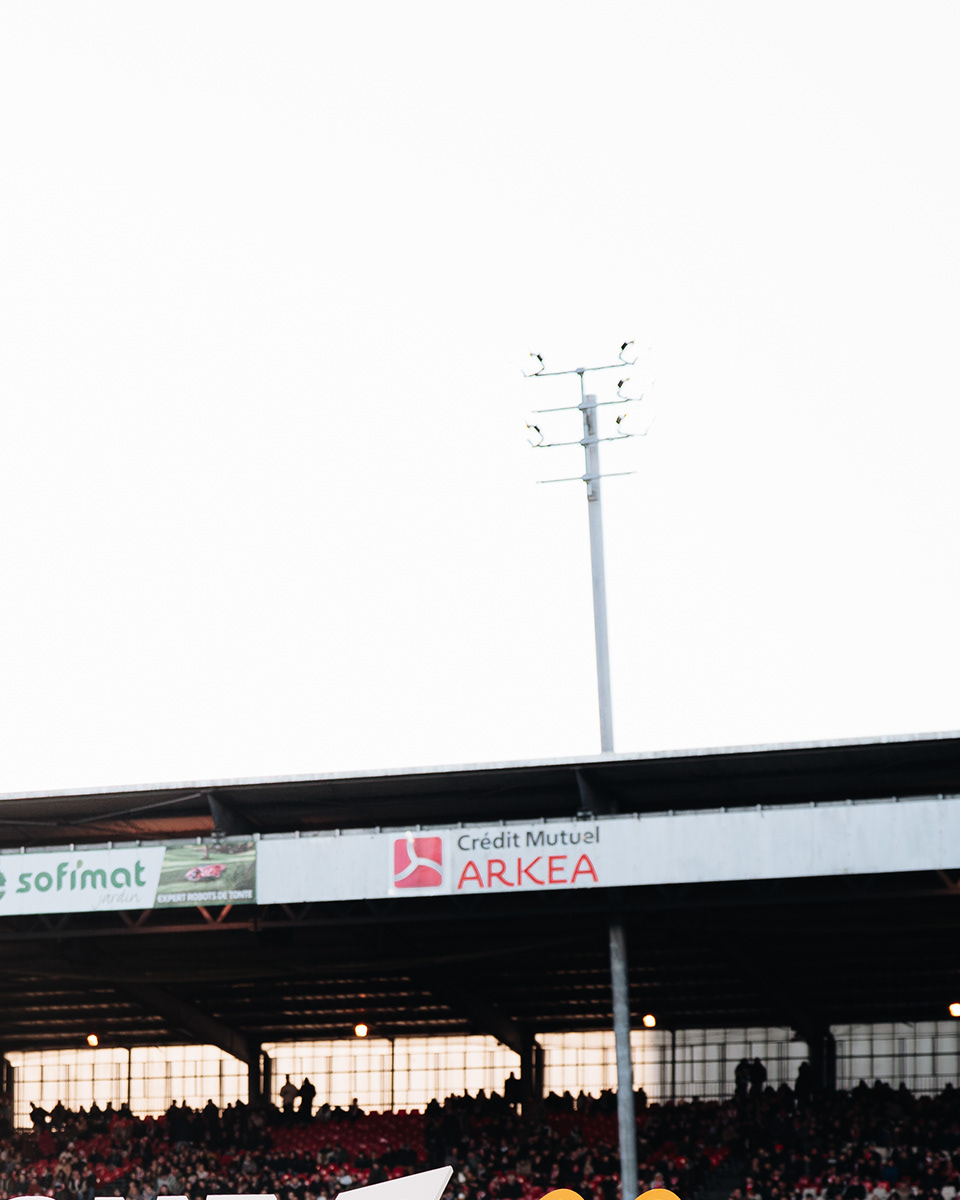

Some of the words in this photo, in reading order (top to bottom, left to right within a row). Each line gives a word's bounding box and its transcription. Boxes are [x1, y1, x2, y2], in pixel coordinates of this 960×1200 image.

[457, 833, 520, 851] Crédit
[525, 826, 600, 847] Mutuel
[16, 860, 146, 893] sofimat
[457, 854, 599, 889] ARKEA
[186, 891, 217, 902] ROBOTS
[217, 890, 228, 900] DE
[228, 888, 253, 899] TONTE
